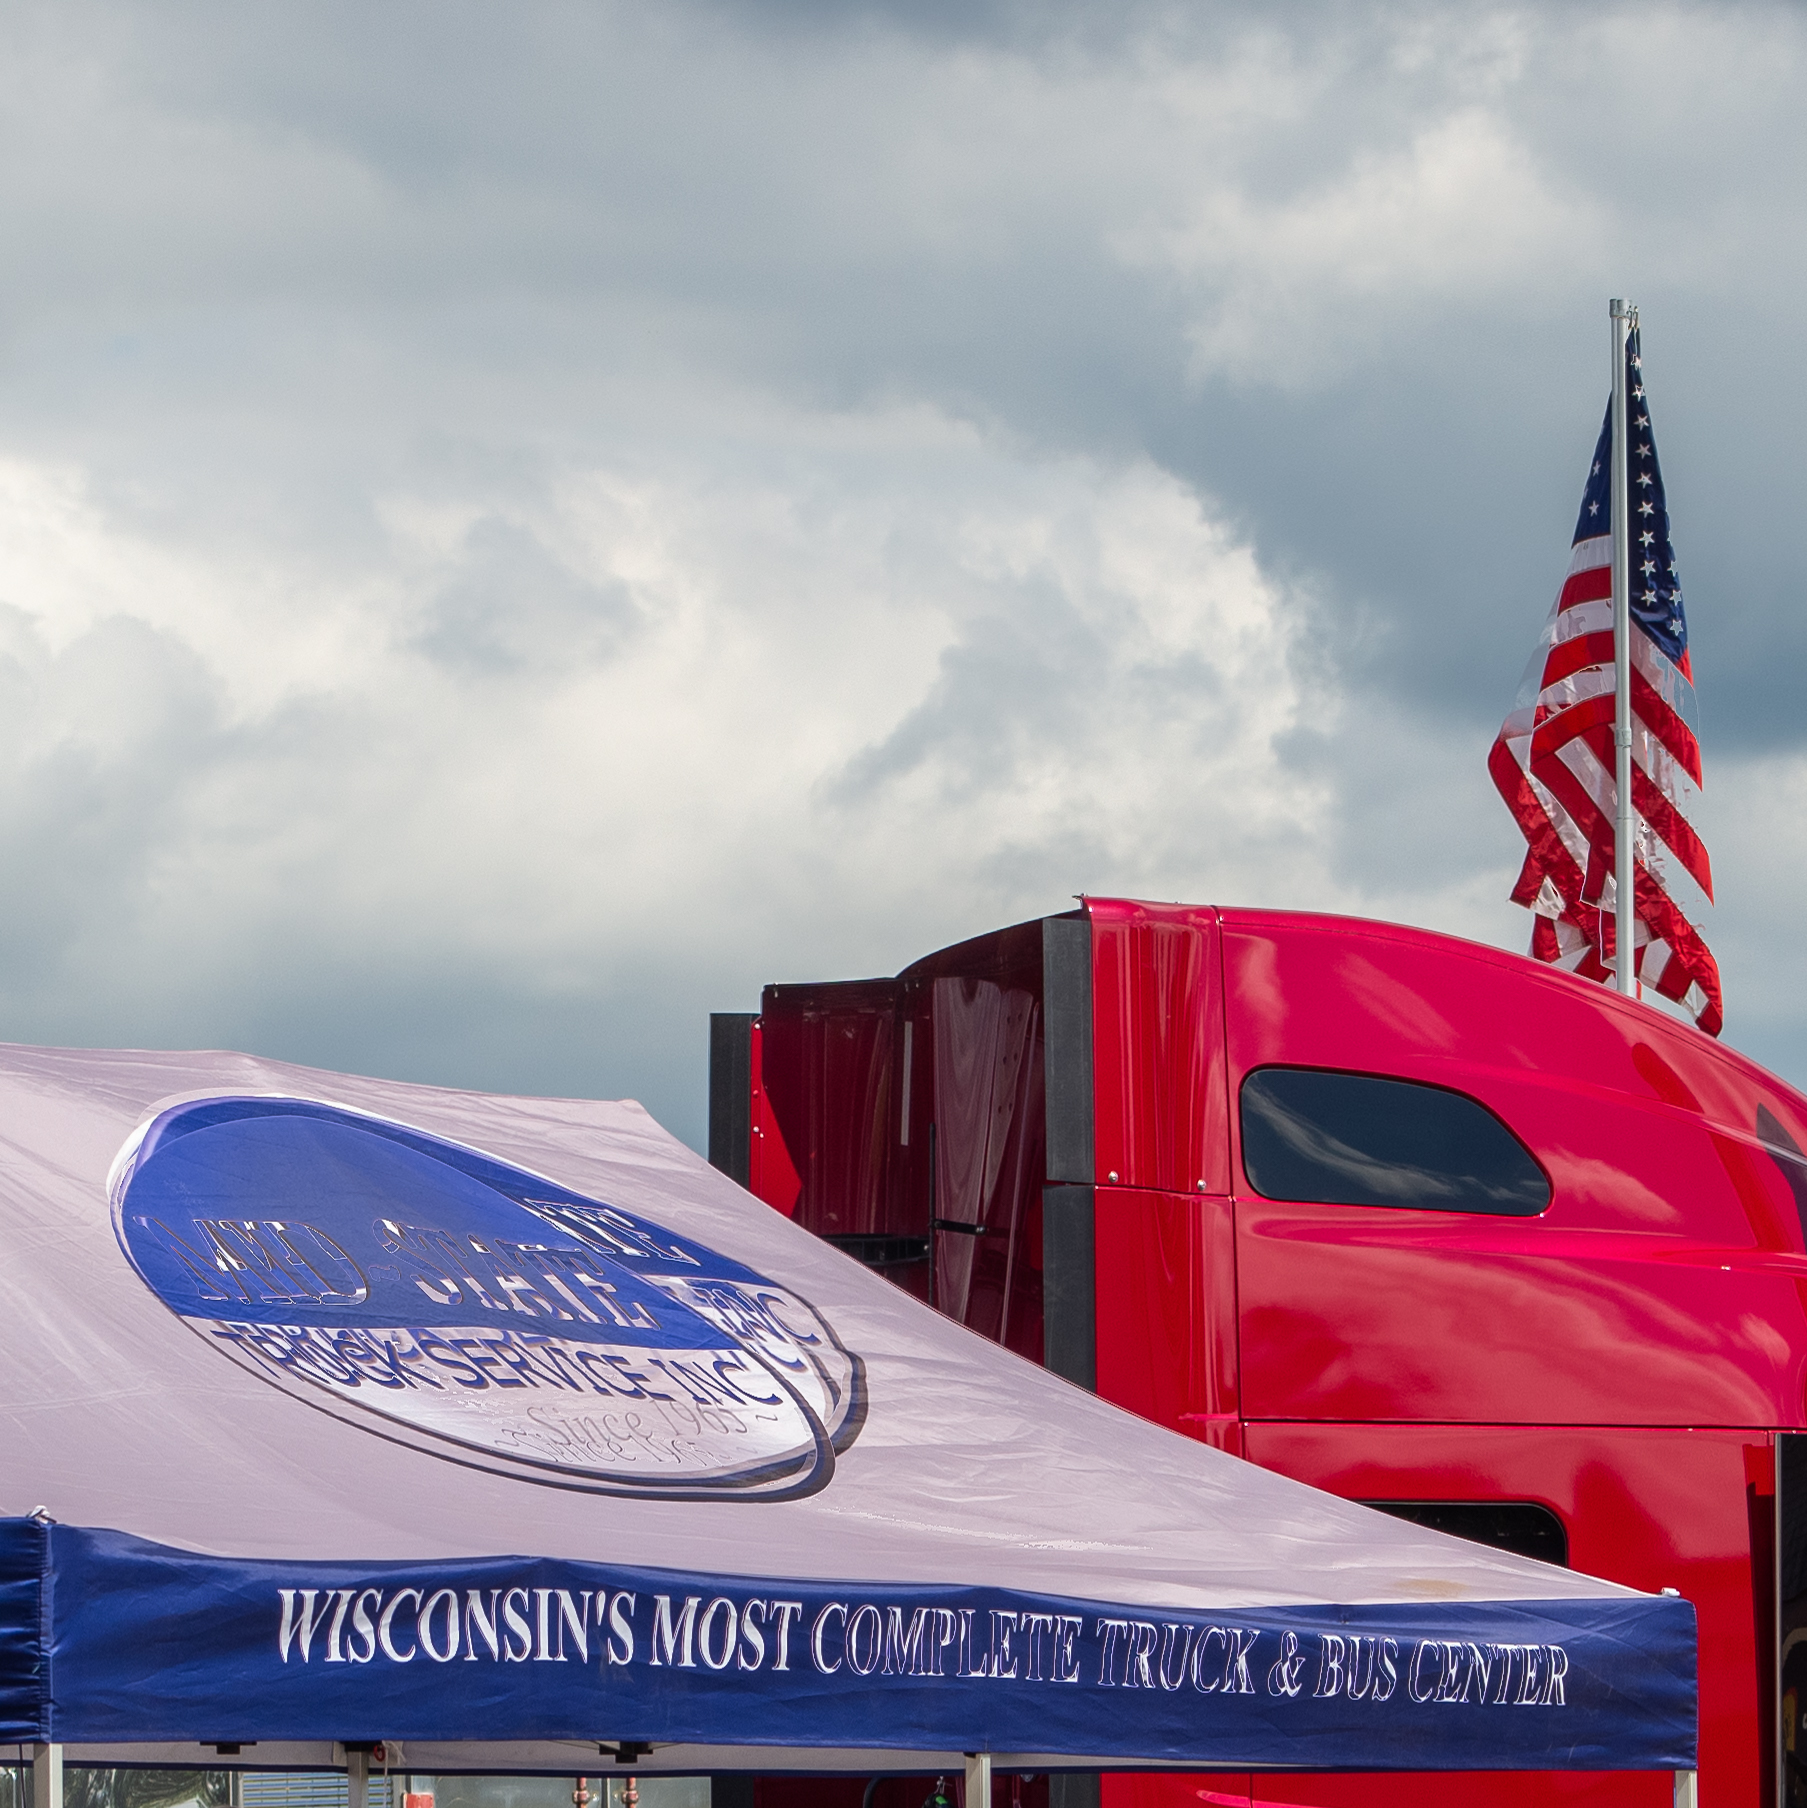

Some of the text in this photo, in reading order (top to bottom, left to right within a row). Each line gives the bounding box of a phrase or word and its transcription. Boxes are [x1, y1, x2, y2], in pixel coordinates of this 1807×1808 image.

[422, 1339, 653, 1401] SERVICE
[662, 1349, 784, 1408] INC
[278, 1588, 1569, 1706] WISCONSIN'S MOST COMPLETE TRUCK & BUS CENTER
